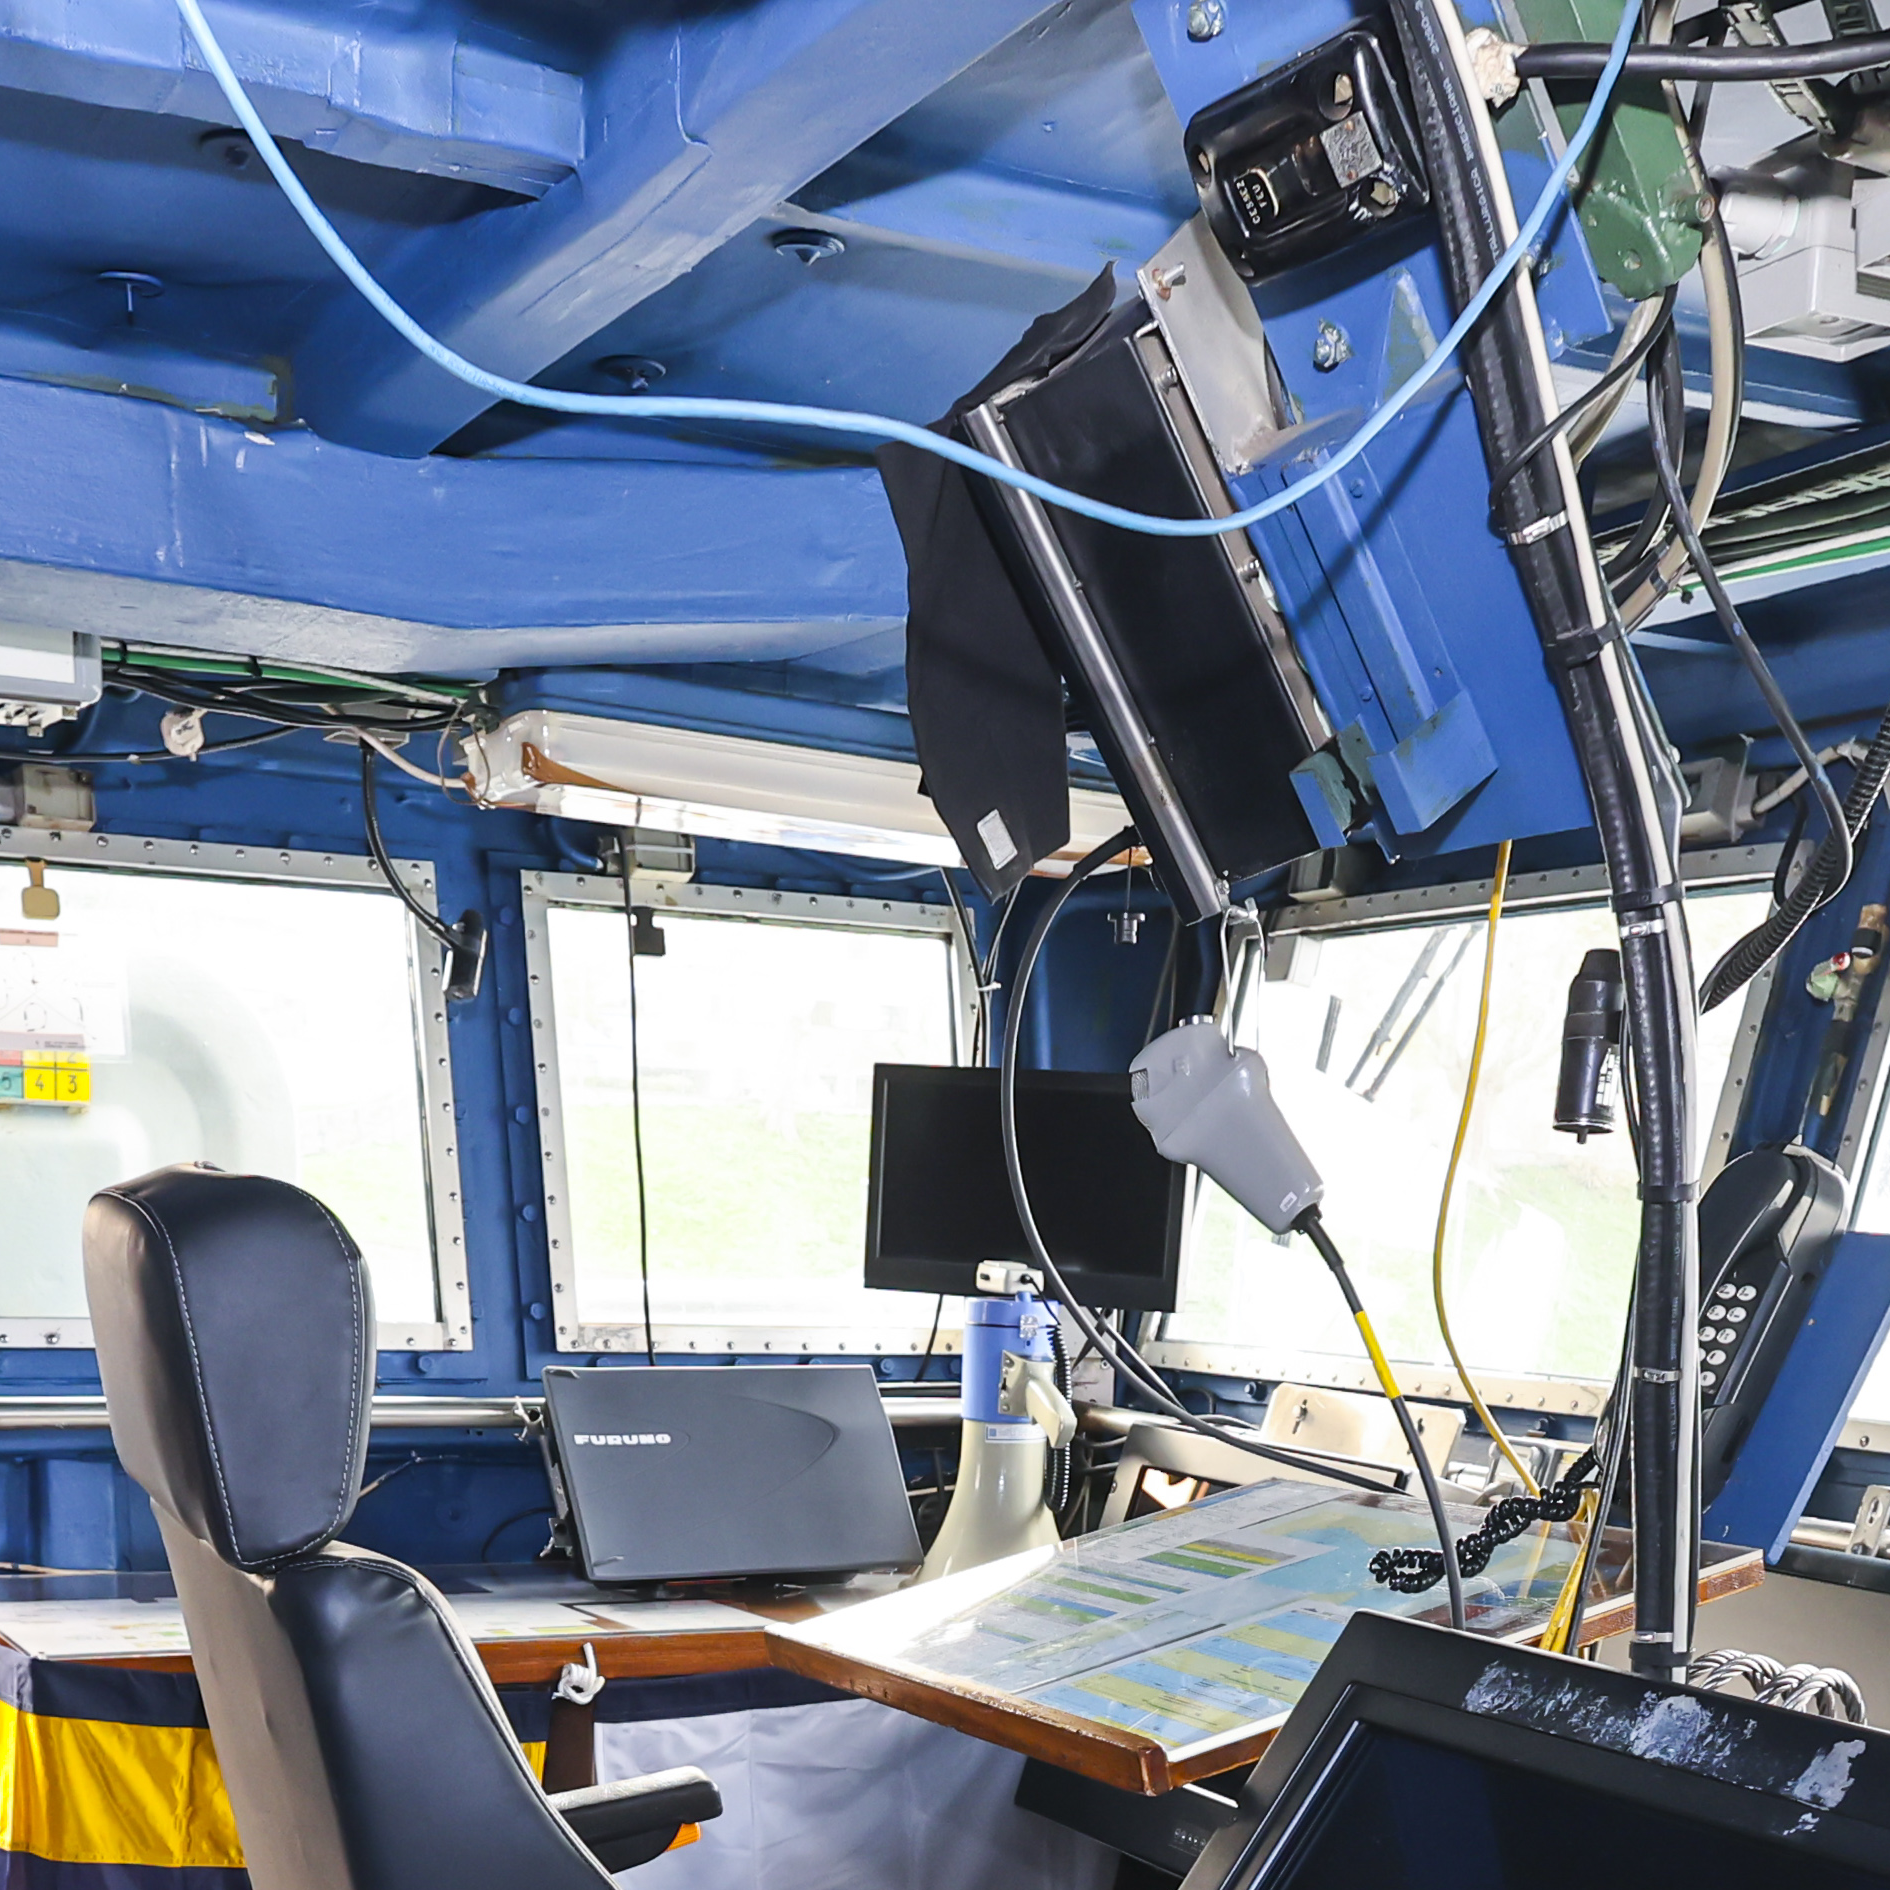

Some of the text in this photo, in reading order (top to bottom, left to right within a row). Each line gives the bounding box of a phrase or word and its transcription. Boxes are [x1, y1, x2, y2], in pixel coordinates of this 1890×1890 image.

[1236, 180, 1260, 225] CESSEZ
[1253, 184, 1267, 208] FEU
[1471, 167, 1500, 265] TALLURGICA
[35, 1074, 44, 1091] 4
[67, 1075, 77, 1094] 3
[574, 1433, 672, 1446] FURUNO
